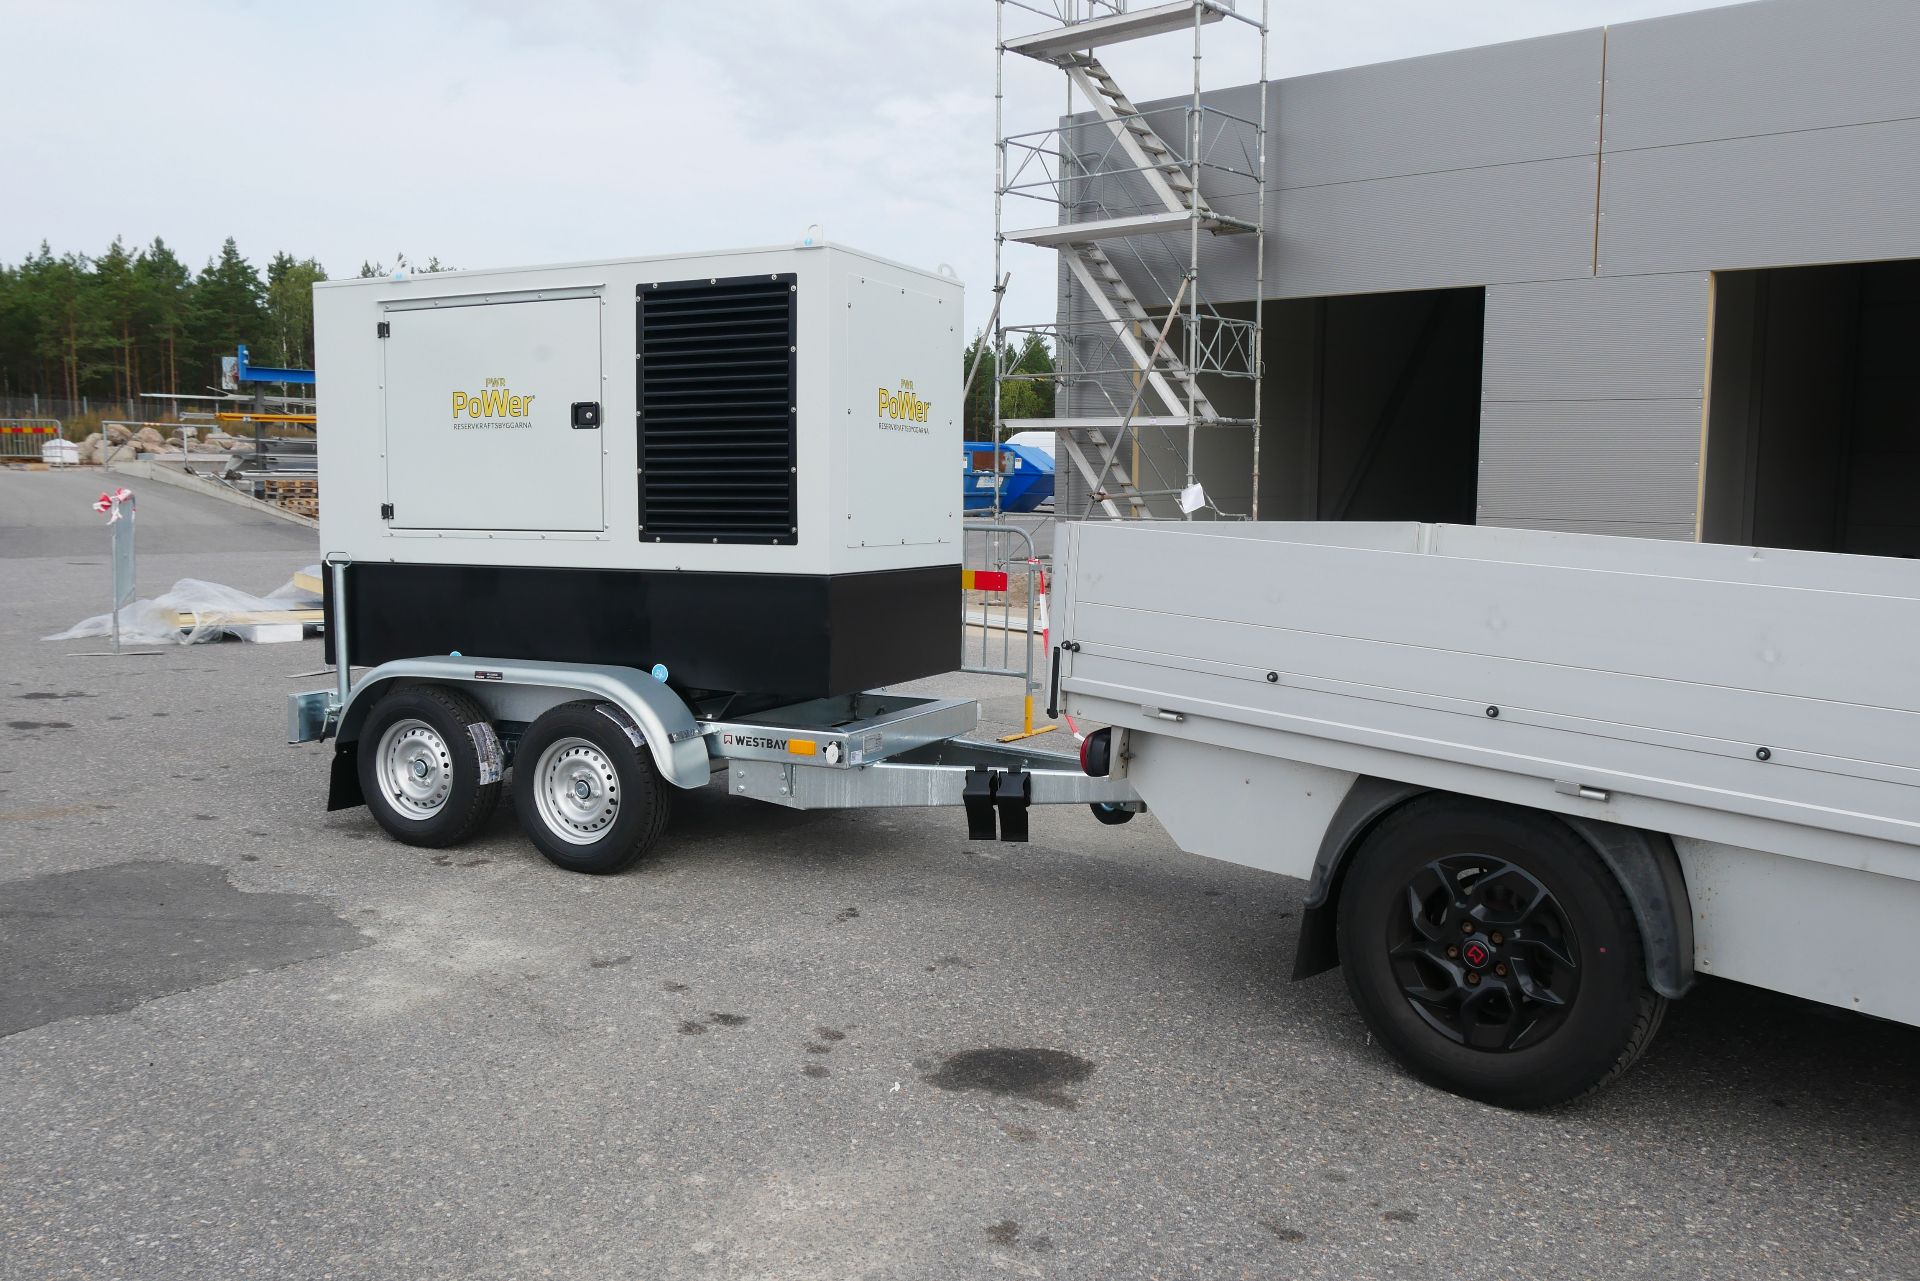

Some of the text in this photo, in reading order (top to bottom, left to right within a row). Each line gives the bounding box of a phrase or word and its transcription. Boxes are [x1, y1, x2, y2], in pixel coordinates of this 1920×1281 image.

[452, 388, 533, 419] PoWer
[878, 387, 930, 423] PoWer
[453, 421, 533, 431] RESERVKRAFTSBYGGARNA
[735, 735, 788, 751] WESTBAY
